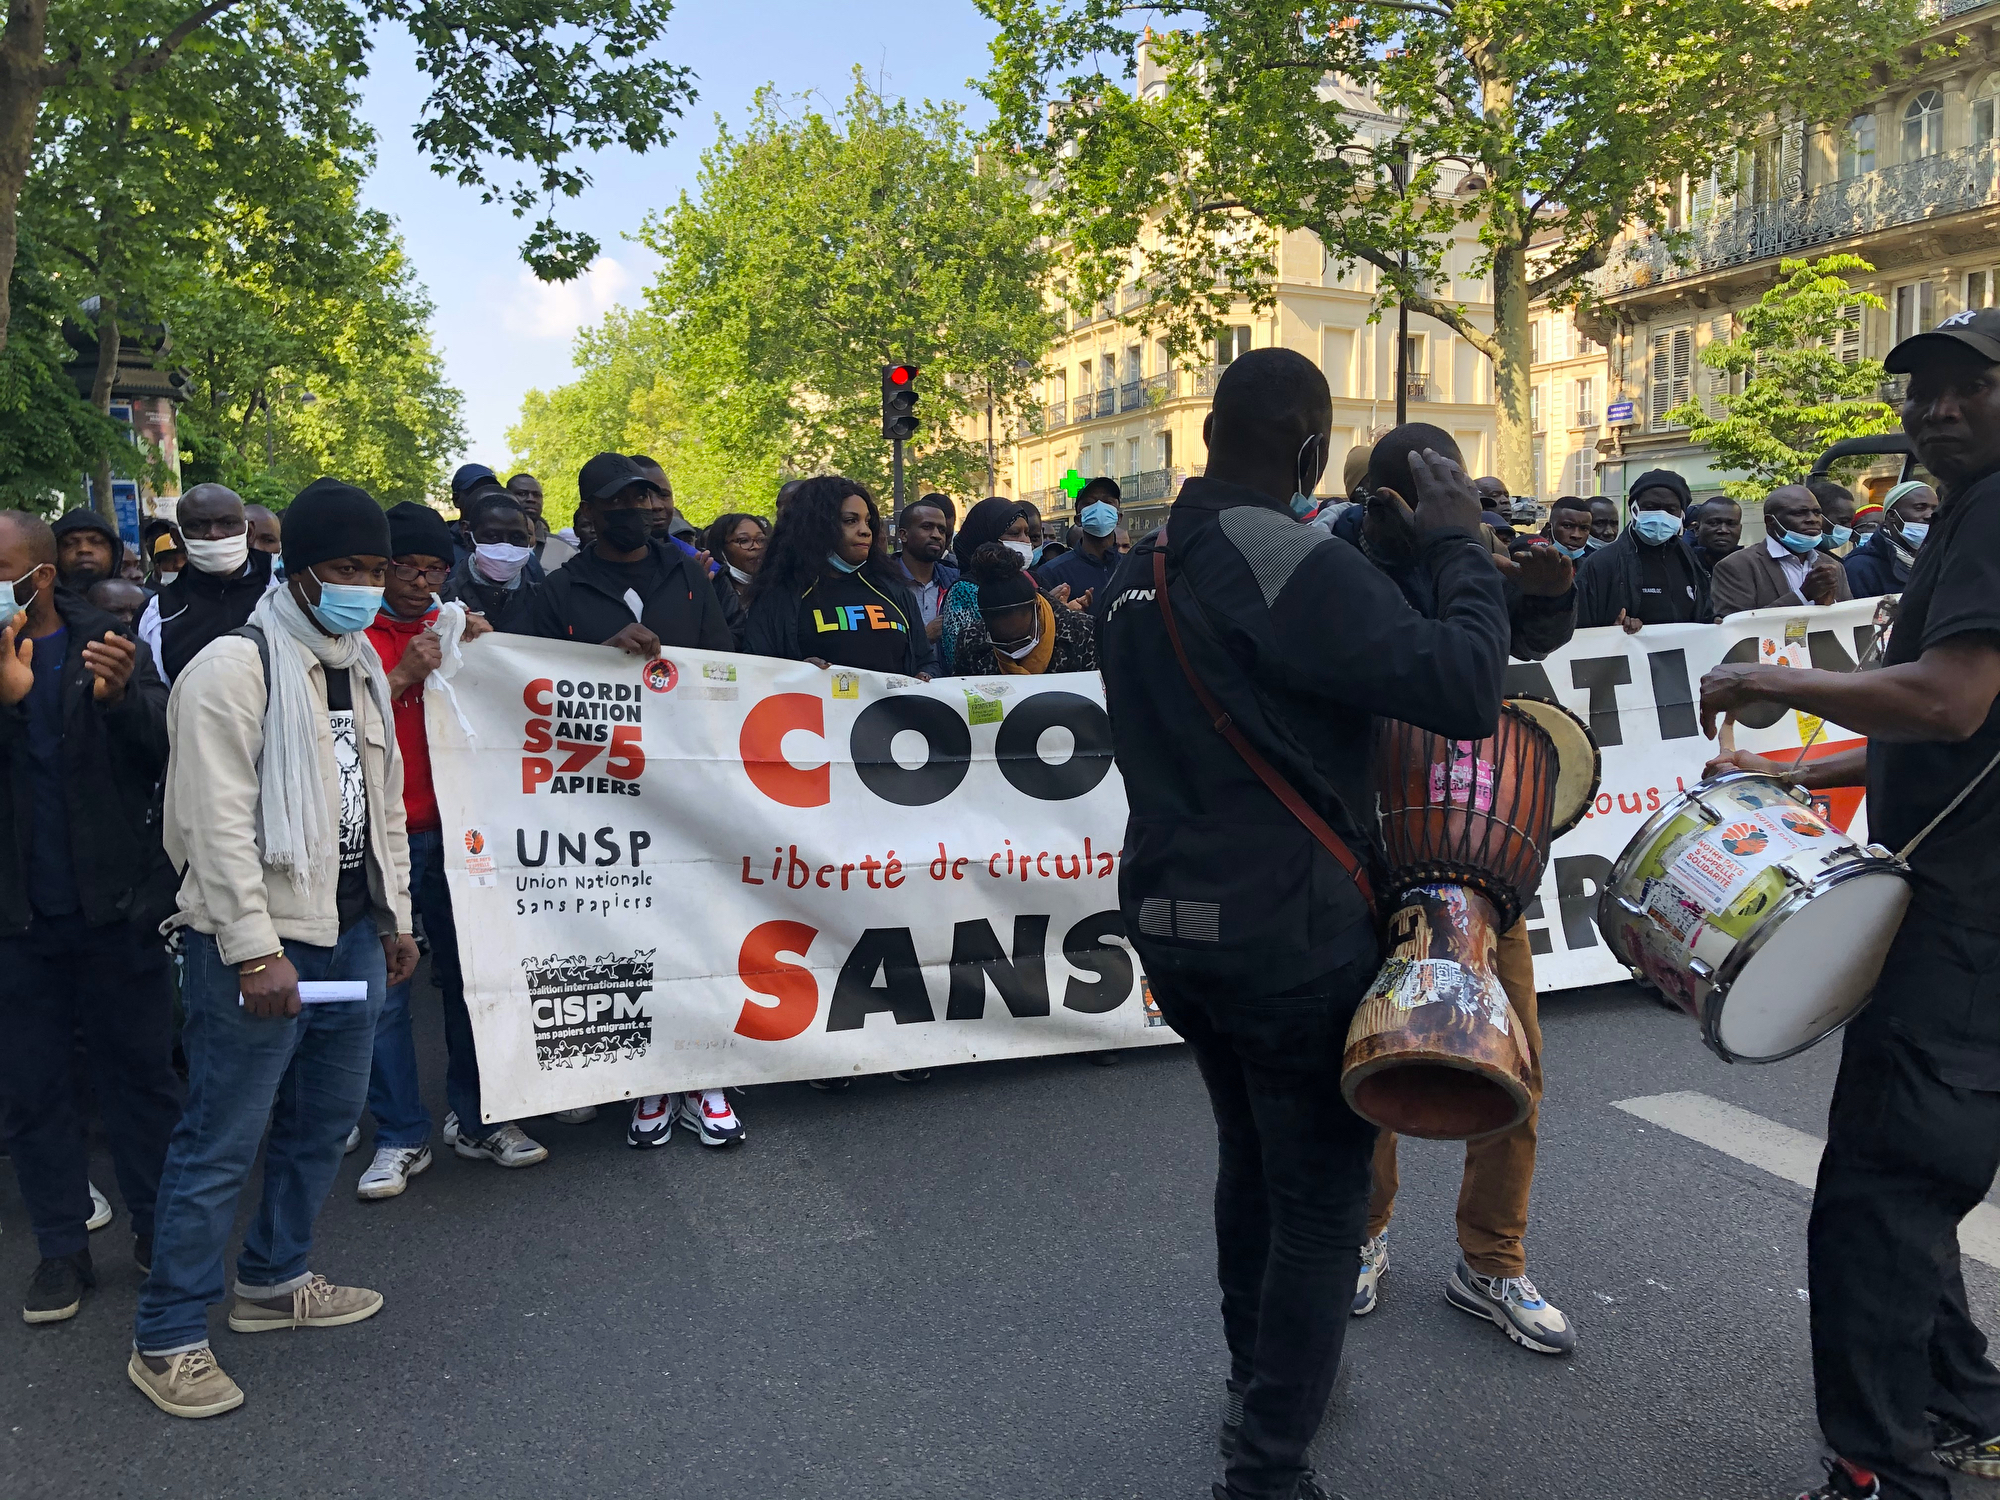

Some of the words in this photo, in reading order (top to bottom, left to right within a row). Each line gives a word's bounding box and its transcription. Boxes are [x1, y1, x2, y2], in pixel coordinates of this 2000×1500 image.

[649, 675, 669, 687] cgt
[557, 700, 642, 723] NATION
[522, 718, 608, 754] SANS
[556, 725, 646, 780] 75
[522, 757, 641, 797] PAPIERS
[1585, 787, 1660, 818] ous
[516, 827, 652, 867] UNSP
[741, 845, 906, 890] Liberté
[929, 842, 970, 881] de
[988, 837, 1122, 882] circula
[1694, 848, 1736, 881] S'APPELLE
[1697, 840, 1723, 861] NOTRE
[1723, 859, 1745, 876] PAYS
[516, 873, 567, 892] Union
[575, 870, 653, 890] Nationale
[1686, 853, 1732, 889] SOLIDARITÉ
[516, 899, 566, 915] Sans
[576, 893, 652, 917] Papiers
[529, 984, 563, 996] coalition
[564, 979, 634, 993] internationale
[635, 978, 653, 988] des
[733, 909, 1134, 1041] SANS
[532, 991, 652, 1029] CISPM
[535, 1032, 551, 1041] sans
[552, 1027, 584, 1041] papiers
[585, 1025, 596, 1034] et
